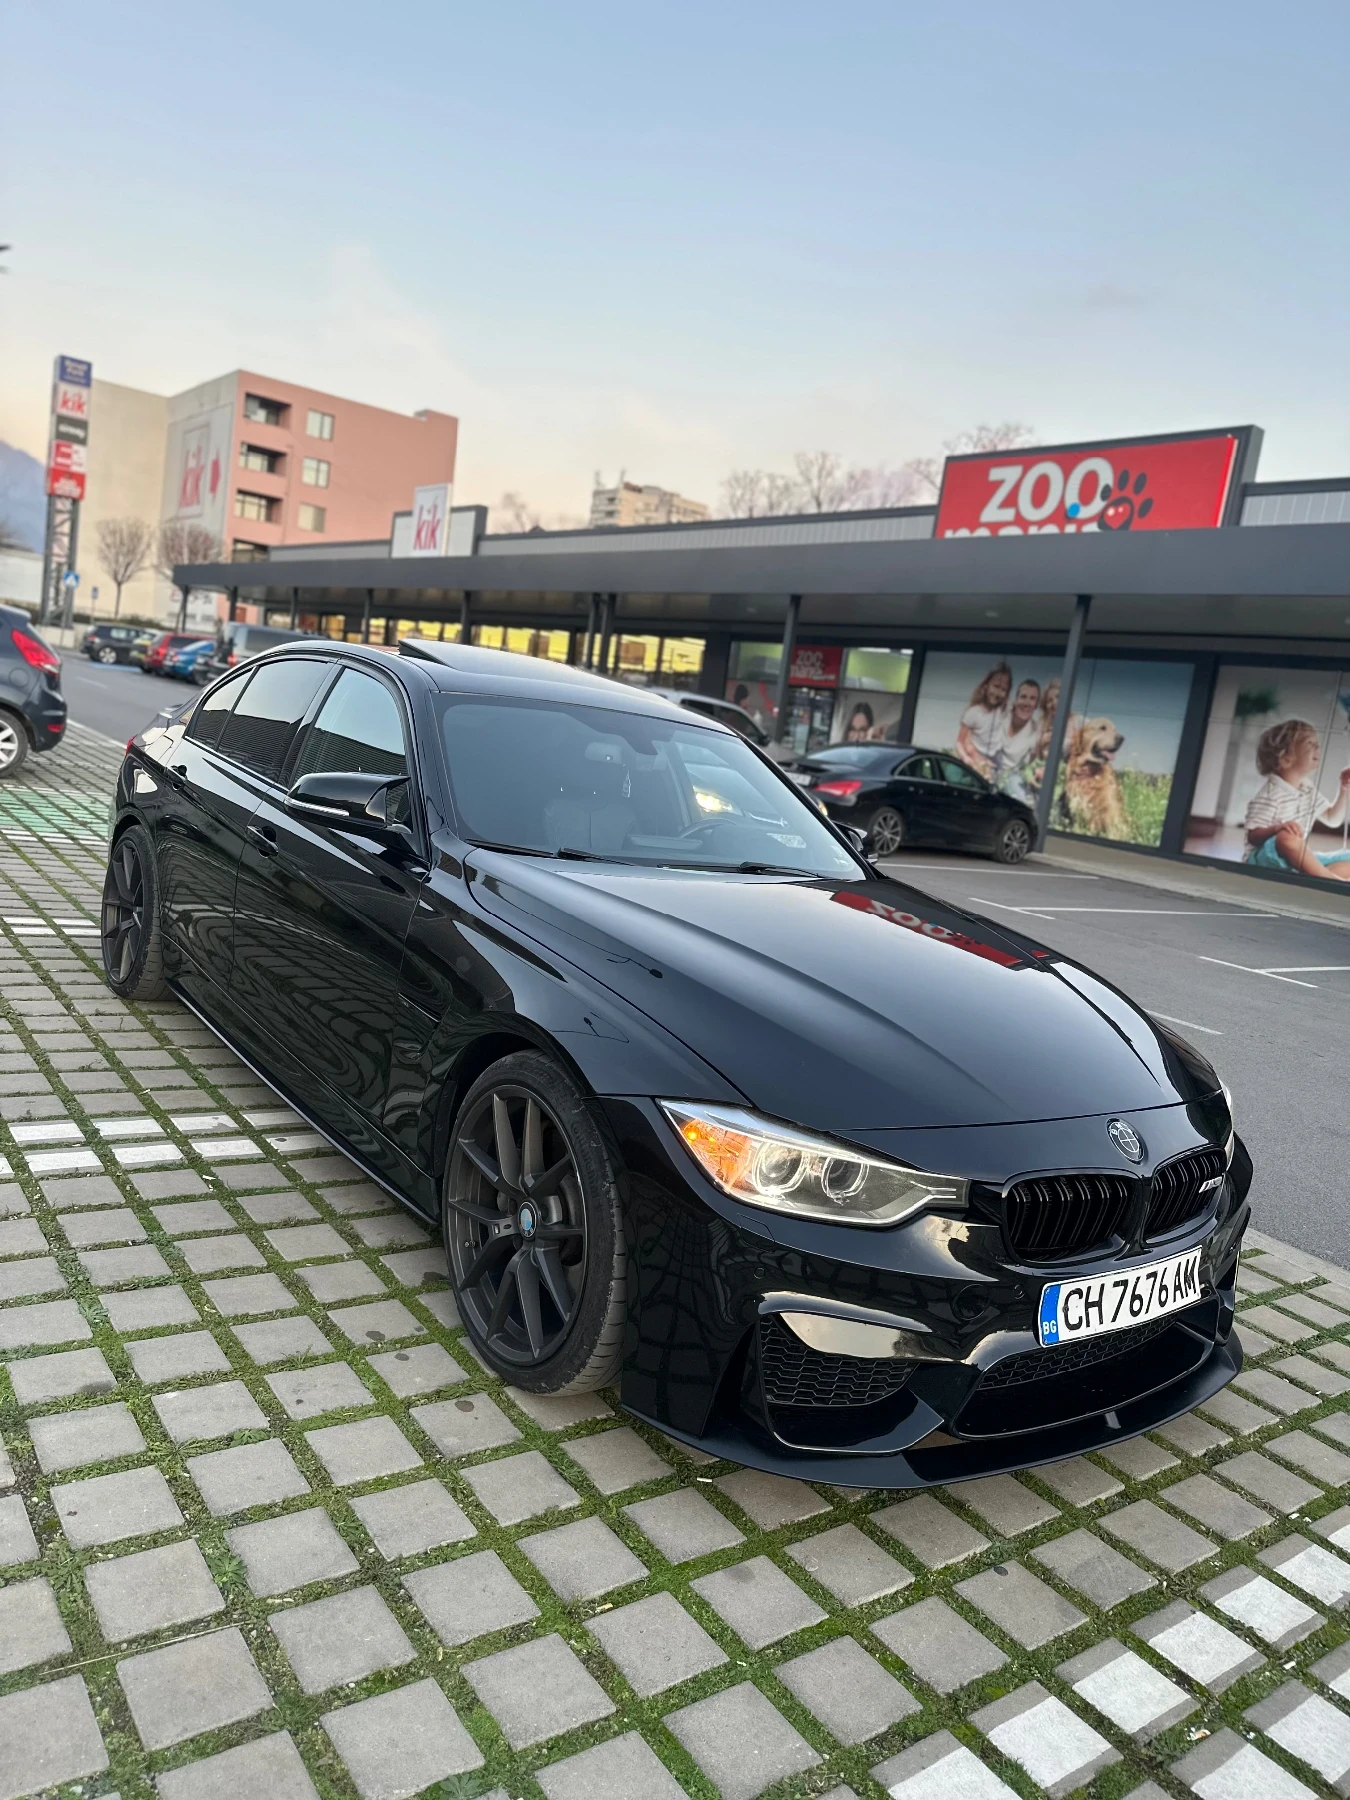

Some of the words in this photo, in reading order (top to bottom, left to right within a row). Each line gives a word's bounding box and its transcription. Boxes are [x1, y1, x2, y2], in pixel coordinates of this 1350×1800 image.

[979, 456, 1114, 523] ZOO
[1062, 1283, 1105, 1331] CH
[1111, 1267, 1169, 1323] 7676
[1173, 1256, 1198, 1302] AM
[1042, 1321, 1057, 1335] BG
